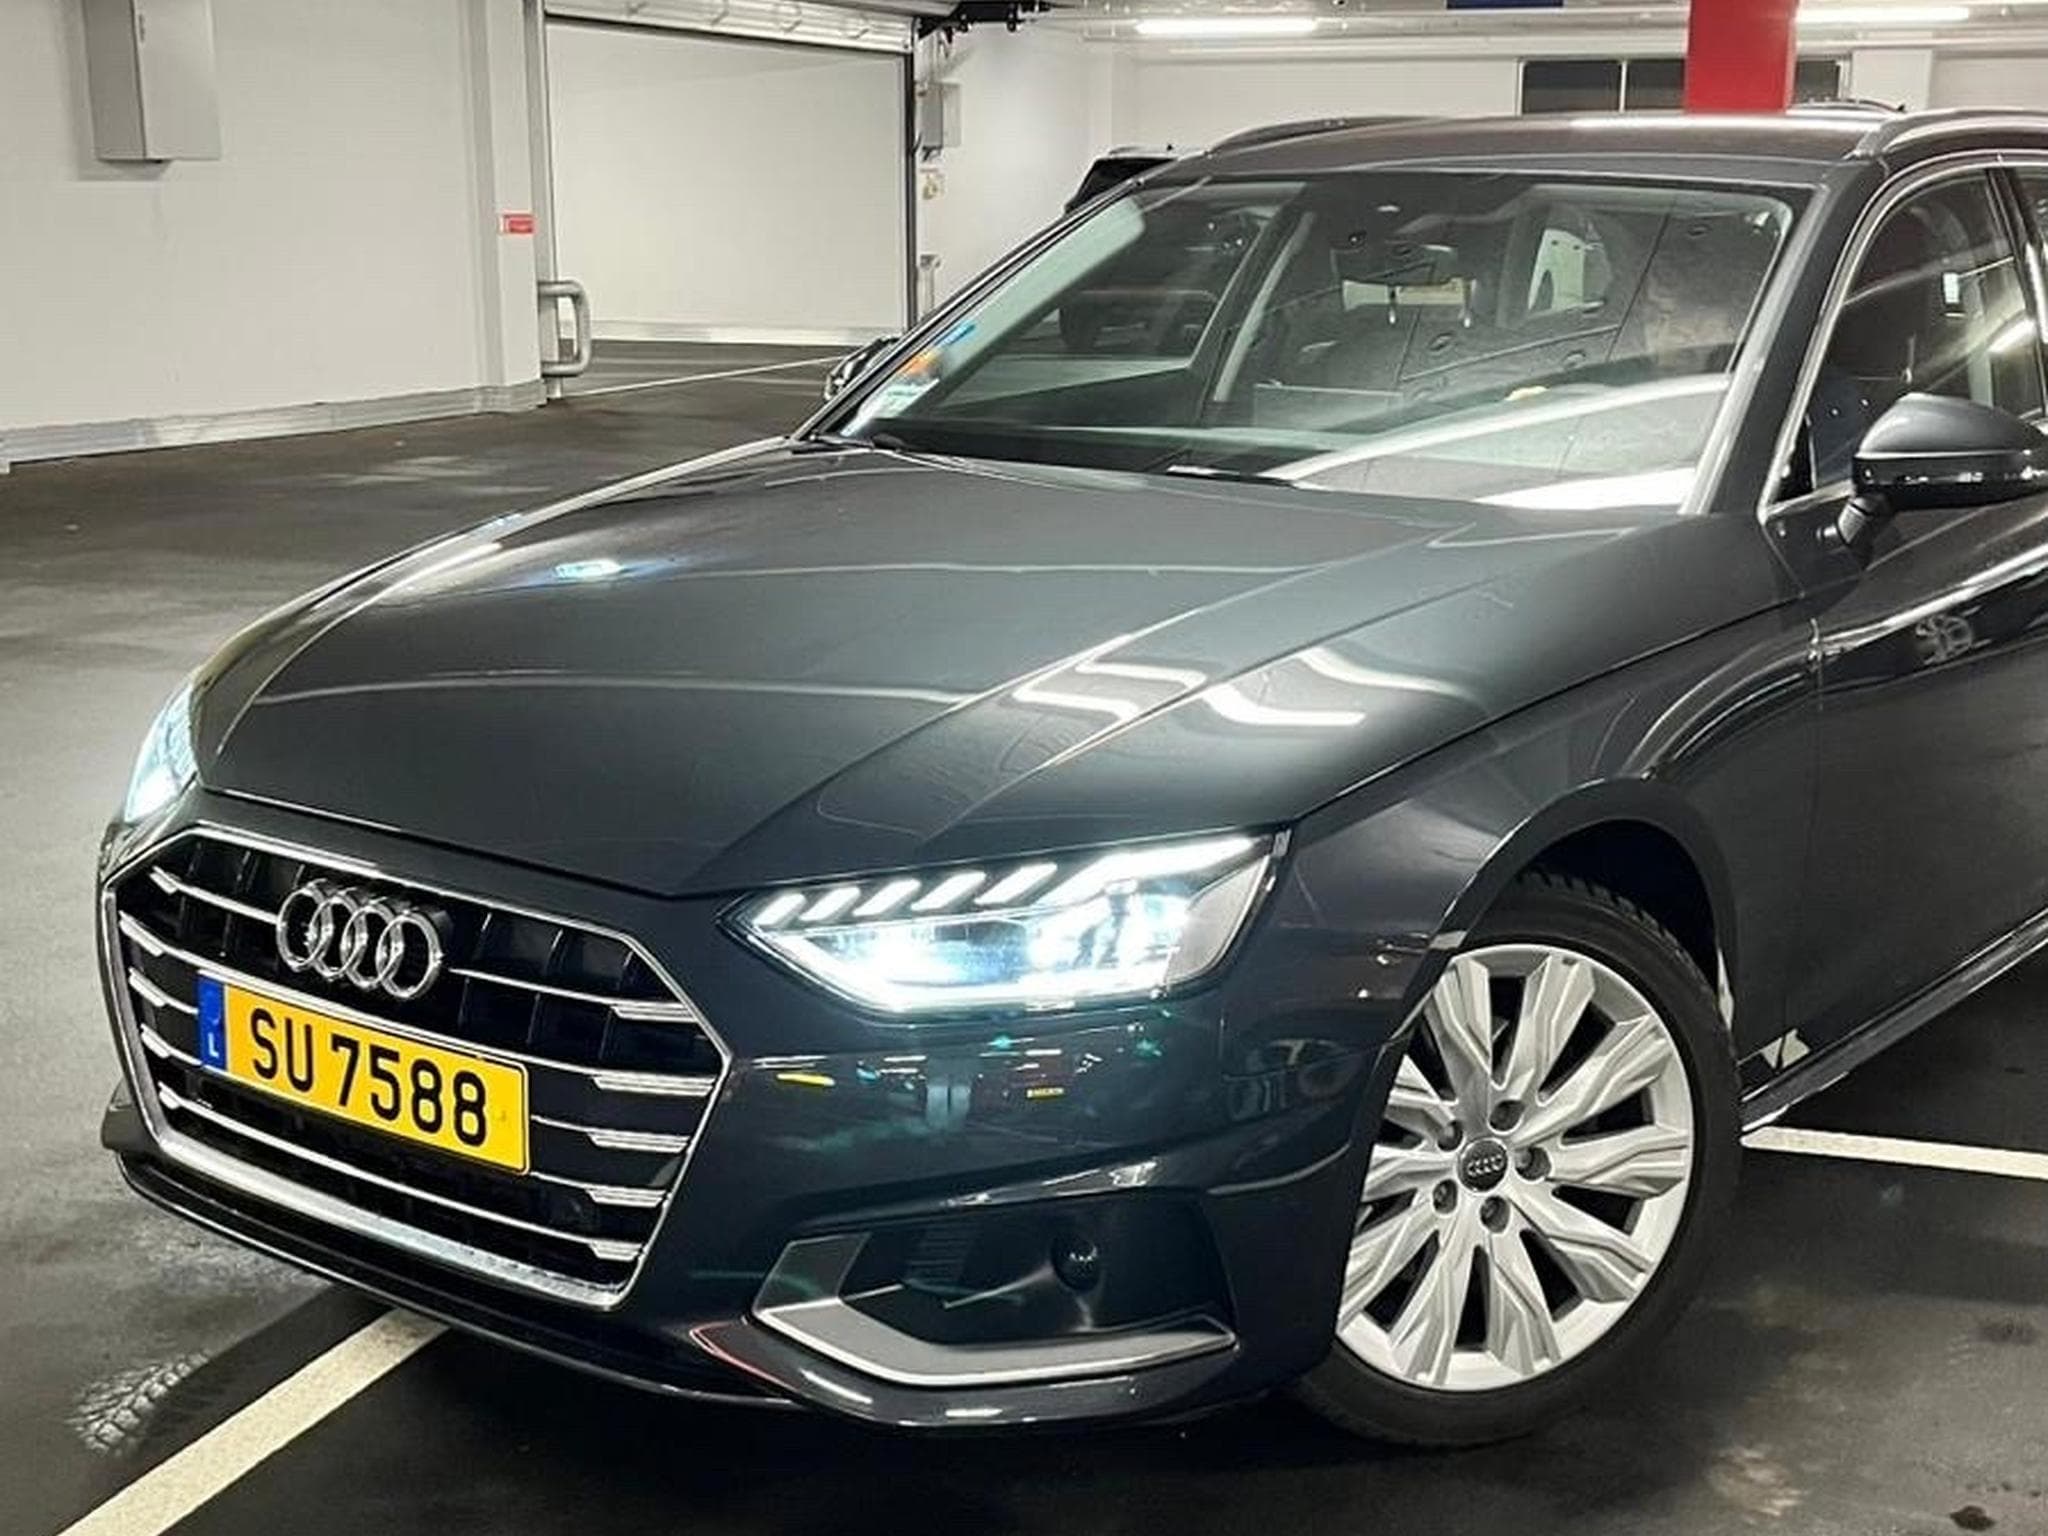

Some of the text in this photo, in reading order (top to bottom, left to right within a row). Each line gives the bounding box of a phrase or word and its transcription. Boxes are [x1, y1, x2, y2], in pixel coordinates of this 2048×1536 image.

[207, 1032, 219, 1058] L
[250, 1008, 487, 1148] SU 7588
